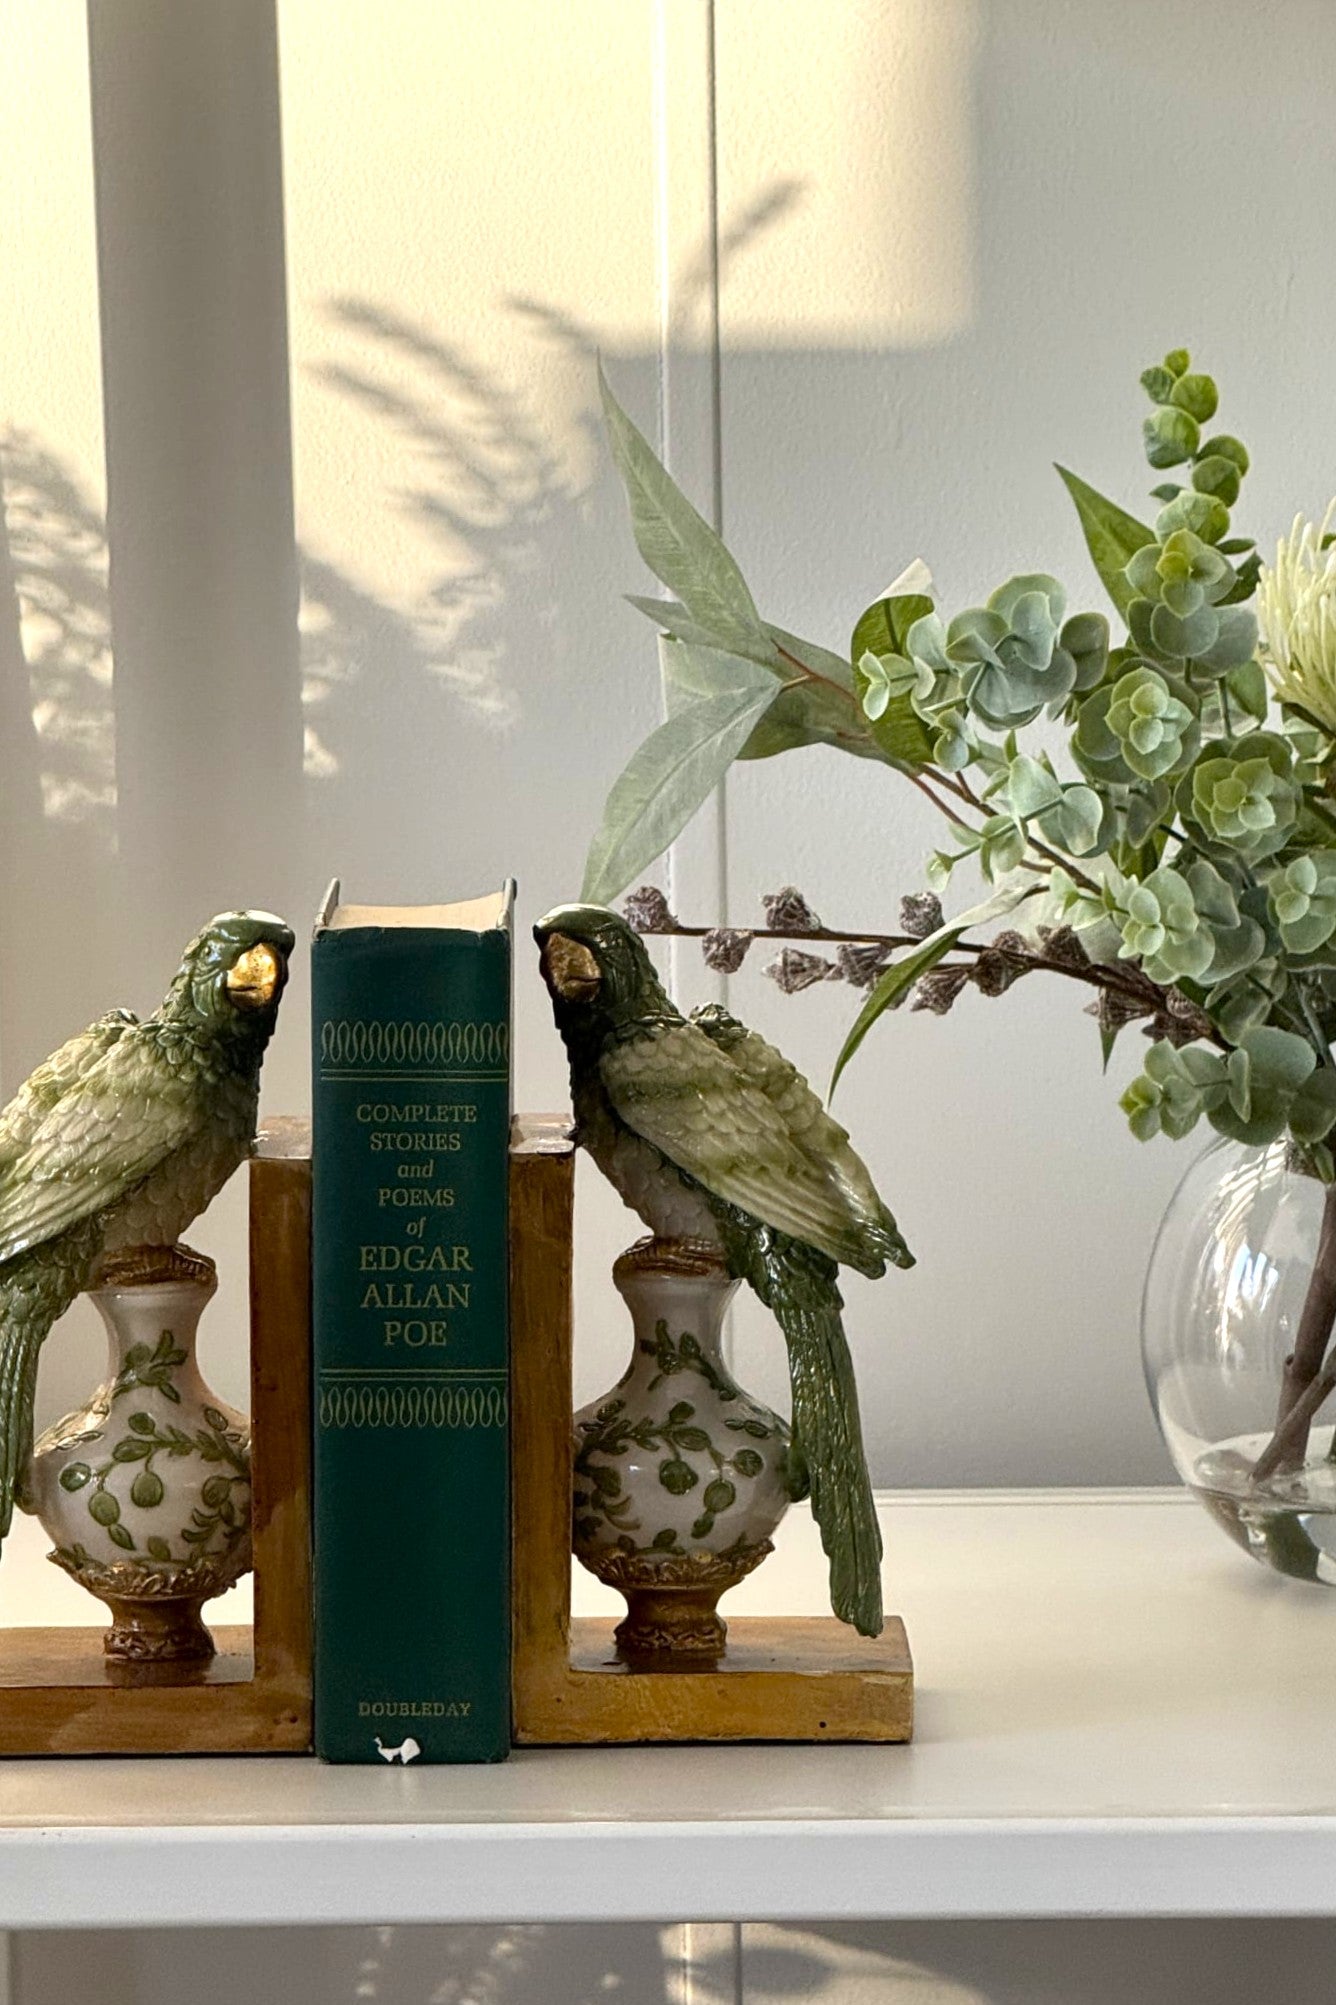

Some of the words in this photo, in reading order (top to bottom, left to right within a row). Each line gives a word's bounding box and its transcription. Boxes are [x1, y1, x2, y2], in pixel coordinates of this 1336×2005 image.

[356, 1104, 477, 1123] COMPLETE
[370, 1132, 461, 1151] STORIES
[397, 1159, 434, 1179] and
[378, 1188, 455, 1207] POEMS
[406, 1216, 427, 1239] of
[359, 1246, 474, 1271] EDGAR
[360, 1283, 471, 1308] ALLAN
[384, 1321, 448, 1347] POE
[358, 1702, 472, 1717] DOUBLEDAY
